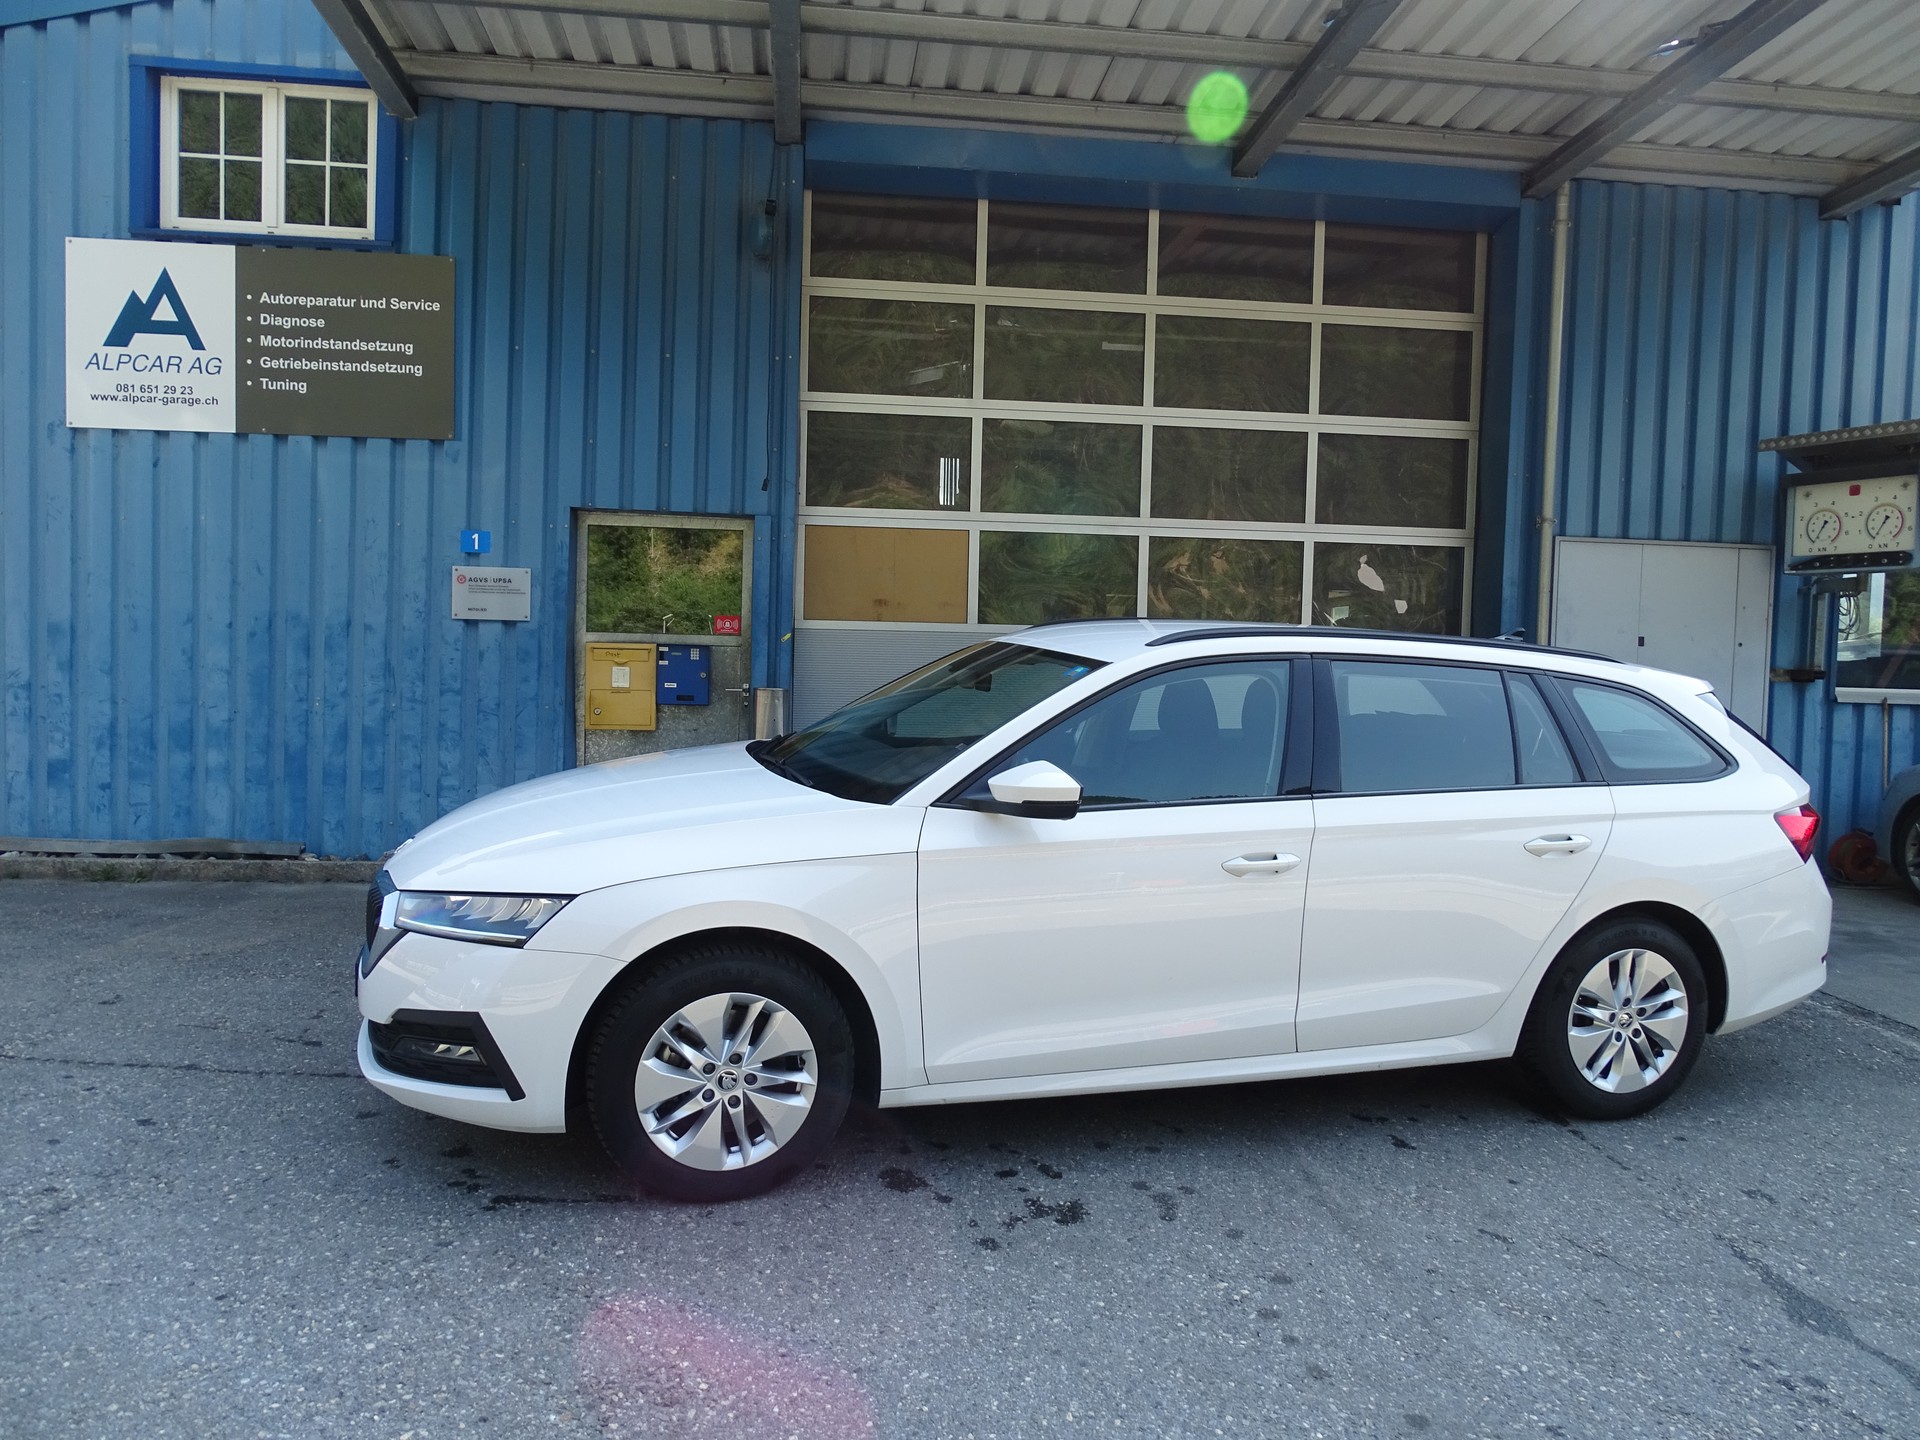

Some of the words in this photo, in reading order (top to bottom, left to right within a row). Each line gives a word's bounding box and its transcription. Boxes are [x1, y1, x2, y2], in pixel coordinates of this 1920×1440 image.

[259, 291, 357, 308] Autoreparatur
[360, 297, 386, 309] und
[390, 298, 441, 311] Service
[259, 313, 326, 328] Diagnose
[259, 335, 414, 355] Motorindstandsetzung
[84, 352, 183, 374] ALPCAR
[187, 356, 223, 376] AG
[259, 356, 423, 376] Getriebeinstandsetzung
[115, 383, 136, 393] 081
[139, 384, 159, 394] 651
[163, 385, 177, 395] 29
[180, 386, 194, 395] 23
[259, 377, 308, 394] Tuning
[90, 393, 219, 407] www.alpcar-garage.ch
[471, 533, 479, 550] 1
[605, 650, 621, 659] Post
